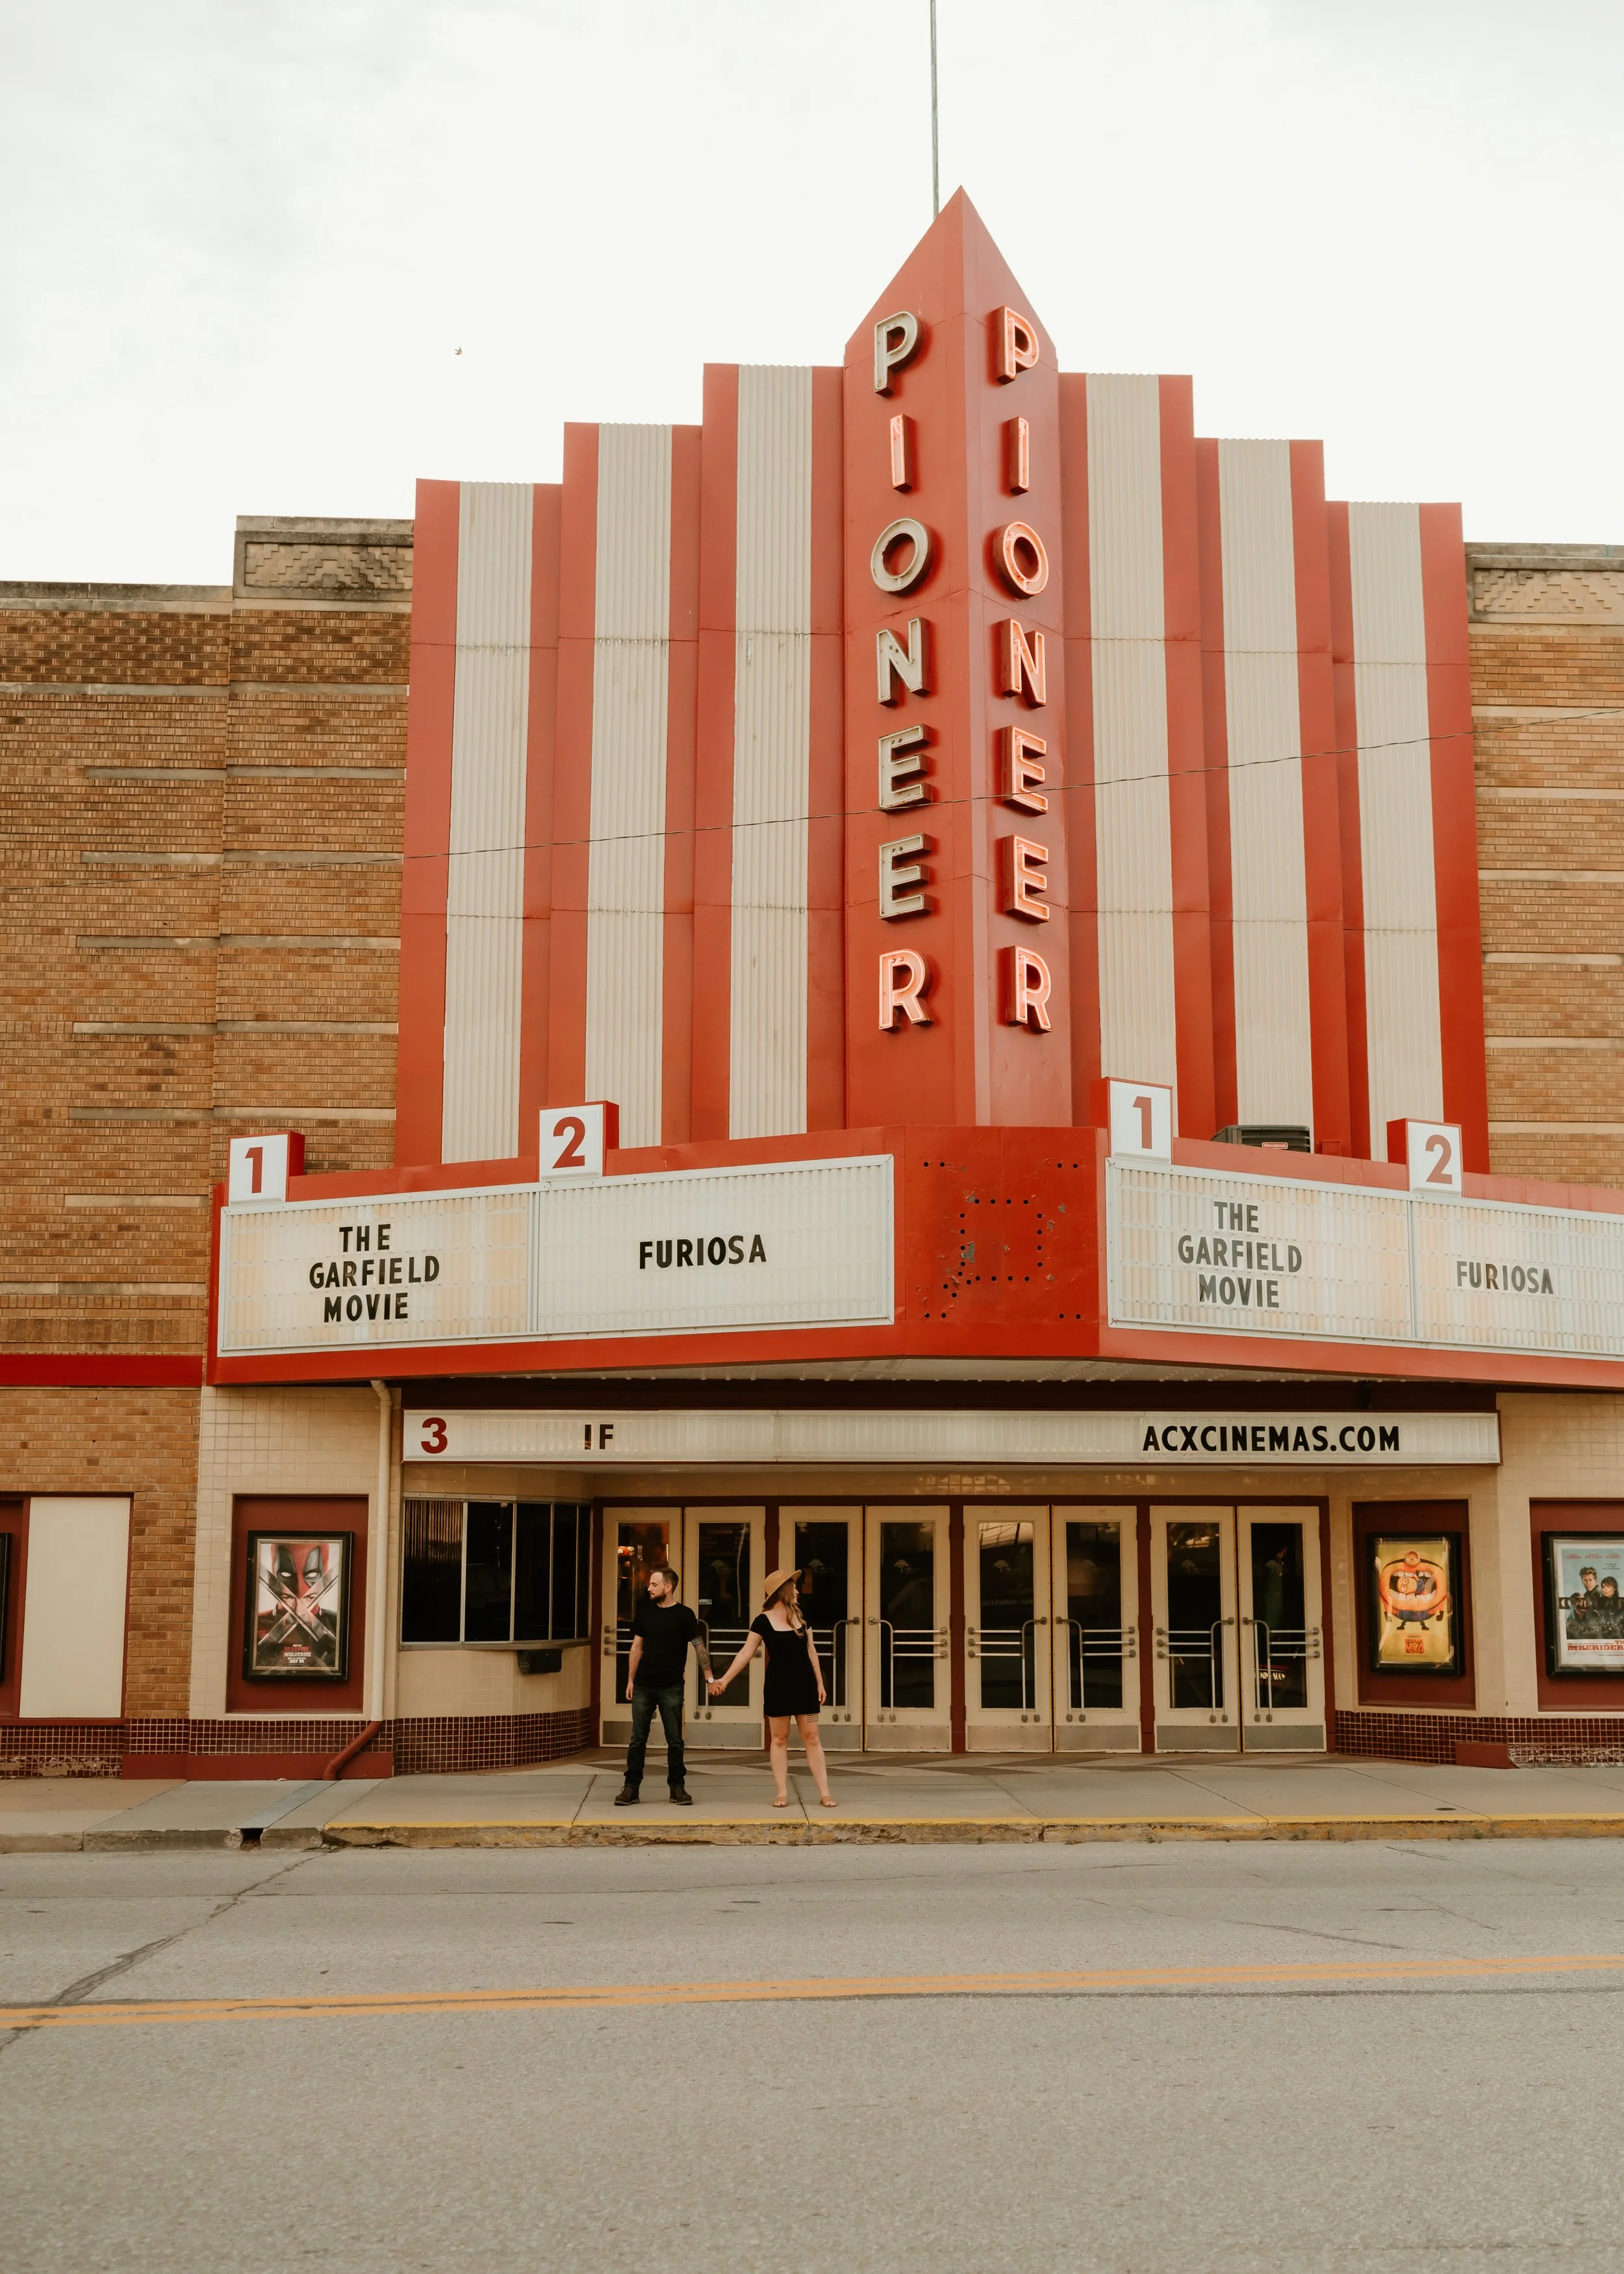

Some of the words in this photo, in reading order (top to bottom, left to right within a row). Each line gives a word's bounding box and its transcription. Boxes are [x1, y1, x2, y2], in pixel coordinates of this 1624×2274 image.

[870, 311, 933, 1032] PIONEER
[995, 305, 1052, 1033] PIONEER
[1132, 1095, 1152, 1149] 1
[553, 1116, 585, 1169] 2
[1425, 1134, 1453, 1184] 2
[246, 1147, 263, 1194] 1
[1213, 1201, 1259, 1233] THE
[339, 1224, 391, 1253] THE
[639, 1234, 767, 1270] FURIOSA
[1178, 1234, 1302, 1273] GARFIELD
[309, 1255, 440, 1289] GARFIELD
[1456, 1261, 1554, 1295] FURIOSA
[324, 1292, 408, 1323] MOVIE
[1199, 1274, 1280, 1308] MOVIE
[421, 1418, 448, 1454] 3
[585, 1424, 614, 1450] IF
[1142, 1425, 1400, 1452] ACXCINEMAS.COM
